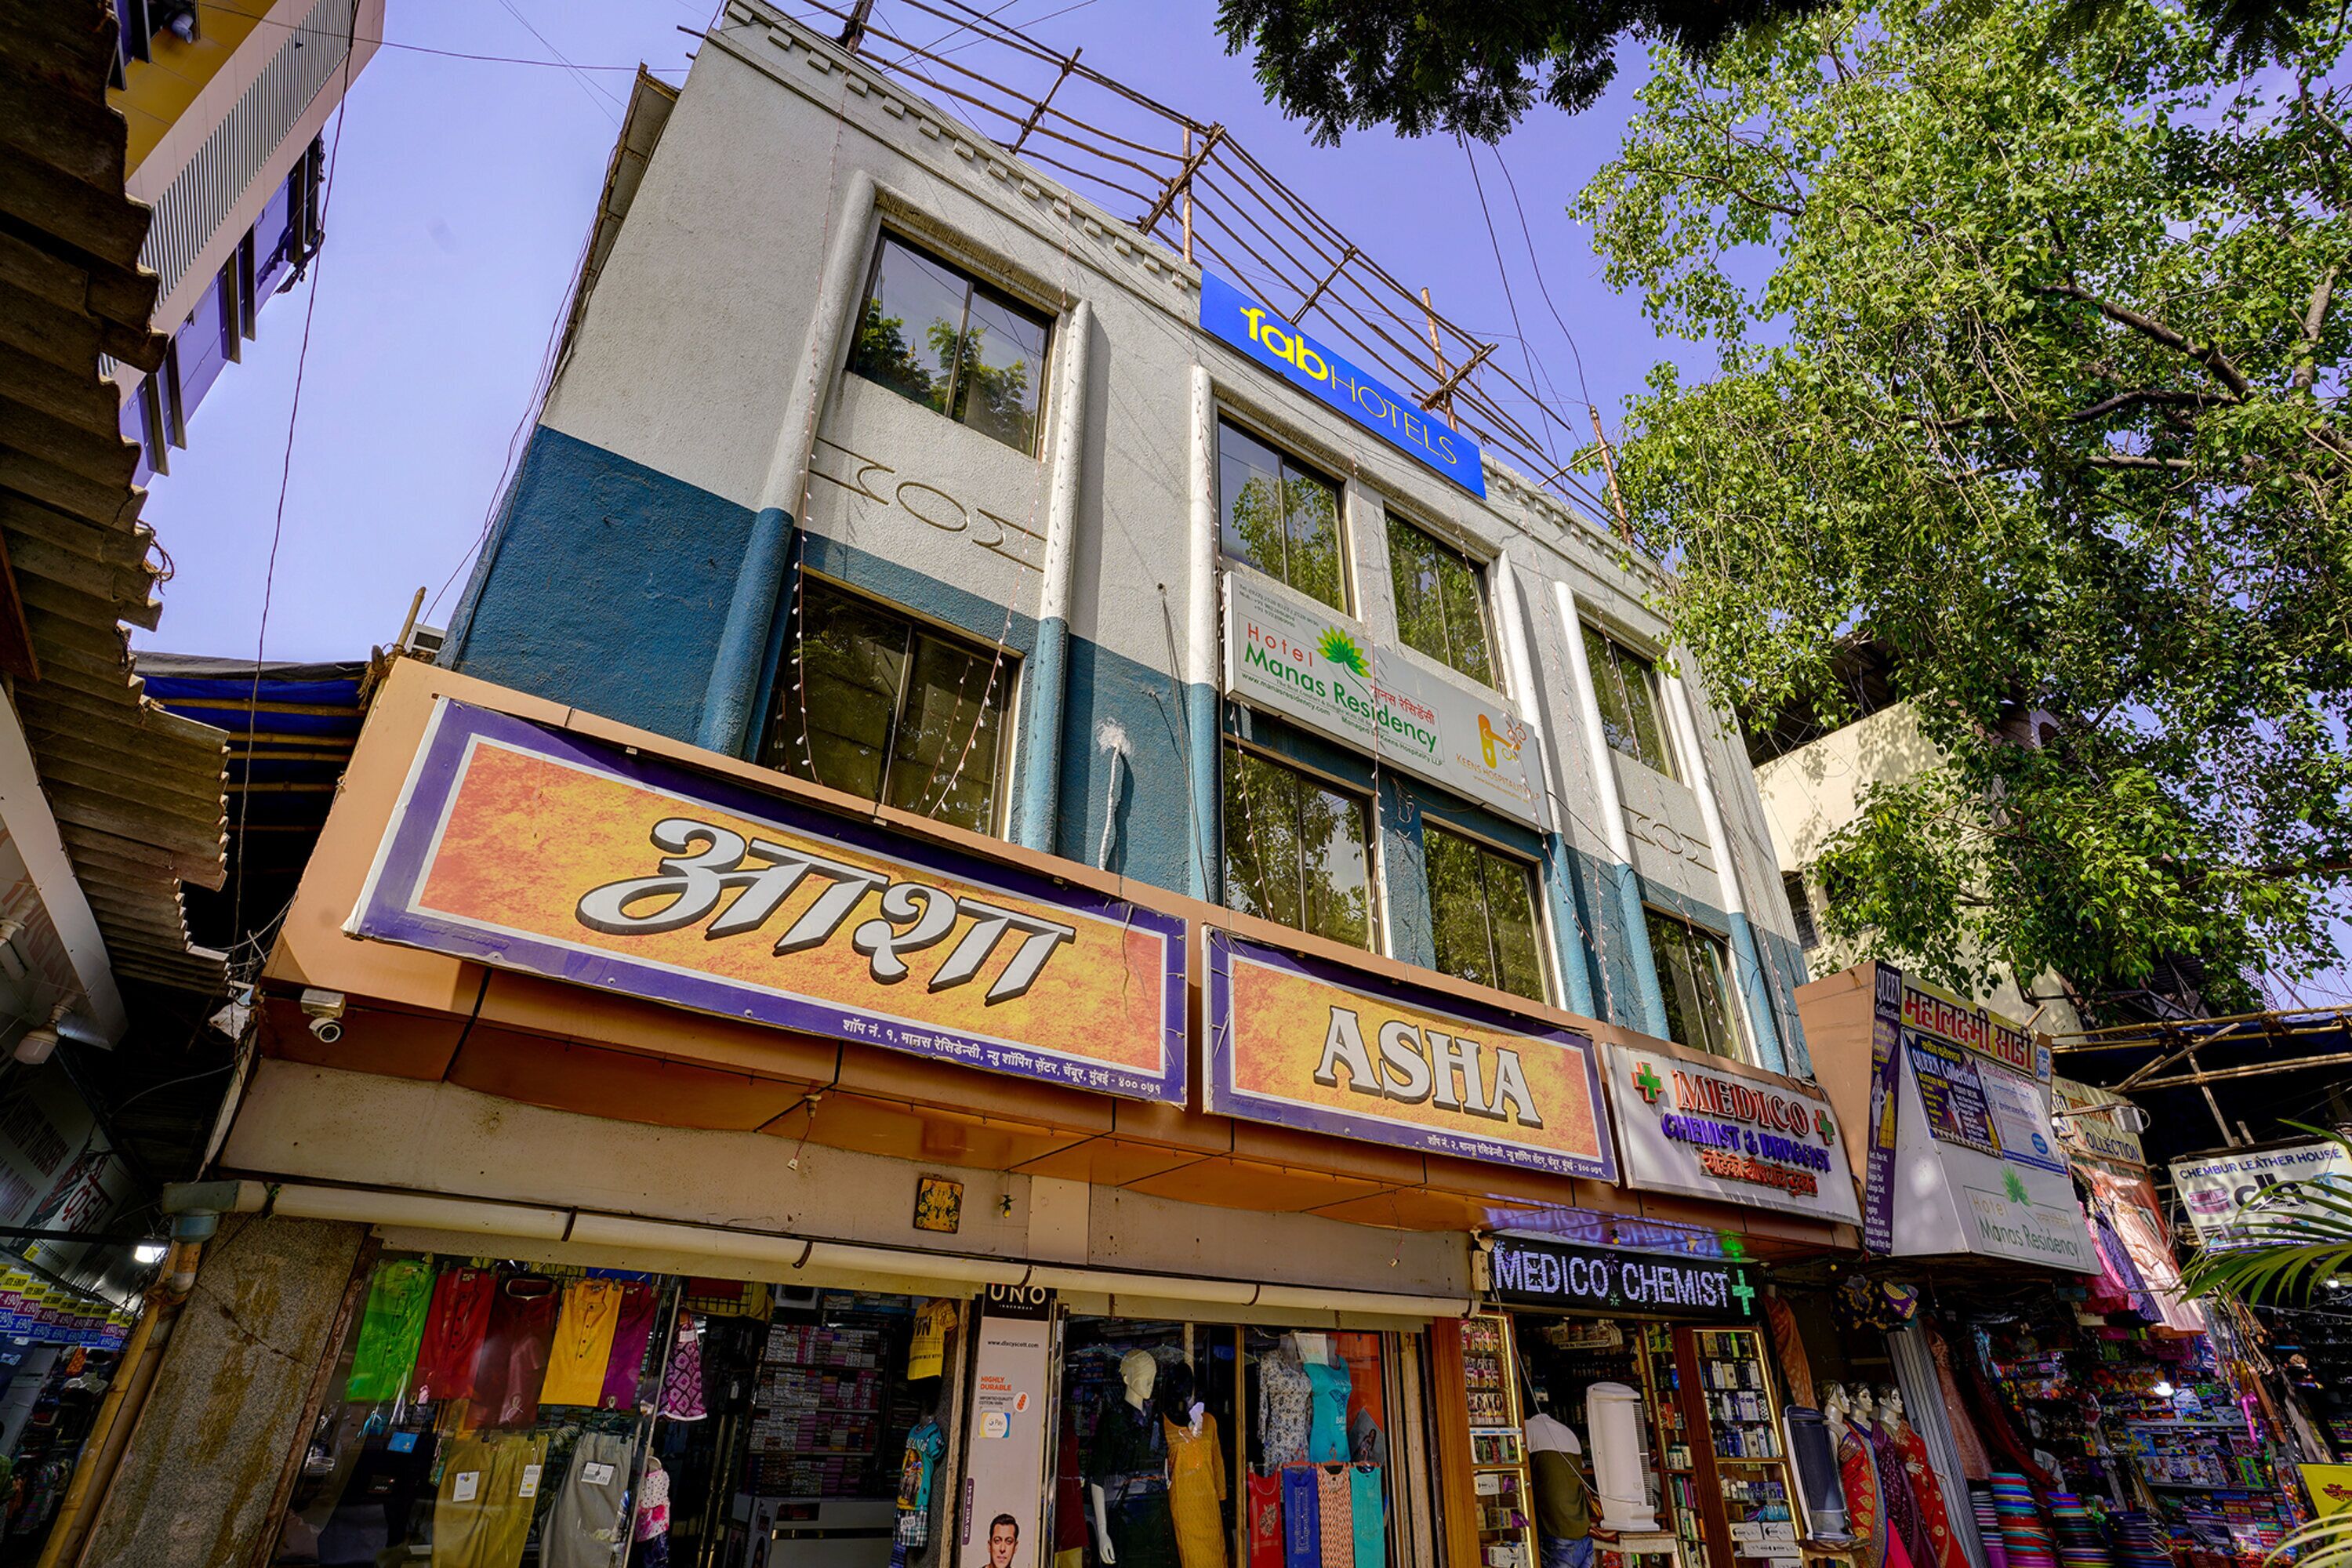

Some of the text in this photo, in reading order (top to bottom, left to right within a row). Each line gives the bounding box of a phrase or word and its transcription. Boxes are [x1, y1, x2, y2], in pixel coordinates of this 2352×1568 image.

[1247, 622, 1313, 668] Hotel
[1244, 641, 1327, 698] Manas
[1334, 681, 1437, 753] Residency
[575, 817, 1076, 1007] आशा
[1876, 968, 1900, 1006] QUEEN
[843, 1018, 866, 1036] शॉप
[902, 1032, 932, 1049] मानस
[1875, 1004, 1900, 1022] Collection
[1994, 1019, 2033, 1070] साडी
[1313, 1005, 1544, 1130] ASHA
[1911, 1047, 1942, 1077] QUEEN
[1940, 1058, 1982, 1091] Collection
[1671, 1069, 1810, 1138] MEDICO
[1661, 1112, 1741, 1151] CHEMIST
[1744, 1129, 1759, 1155] &
[2180, 1149, 2343, 1180] CHEMBUR LEATHER HOUSE
[1972, 1193, 2009, 1217] Hotel
[1978, 1215, 2024, 1247] Manas
[2021, 1224, 2080, 1263] Residency
[990, 1283, 1047, 1305] UNO
[1494, 1249, 1729, 1308] MEDICO CHEMIST
[980, 1383, 1011, 1392] DURABLE
[981, 1375, 1004, 1384] HIGHLY
